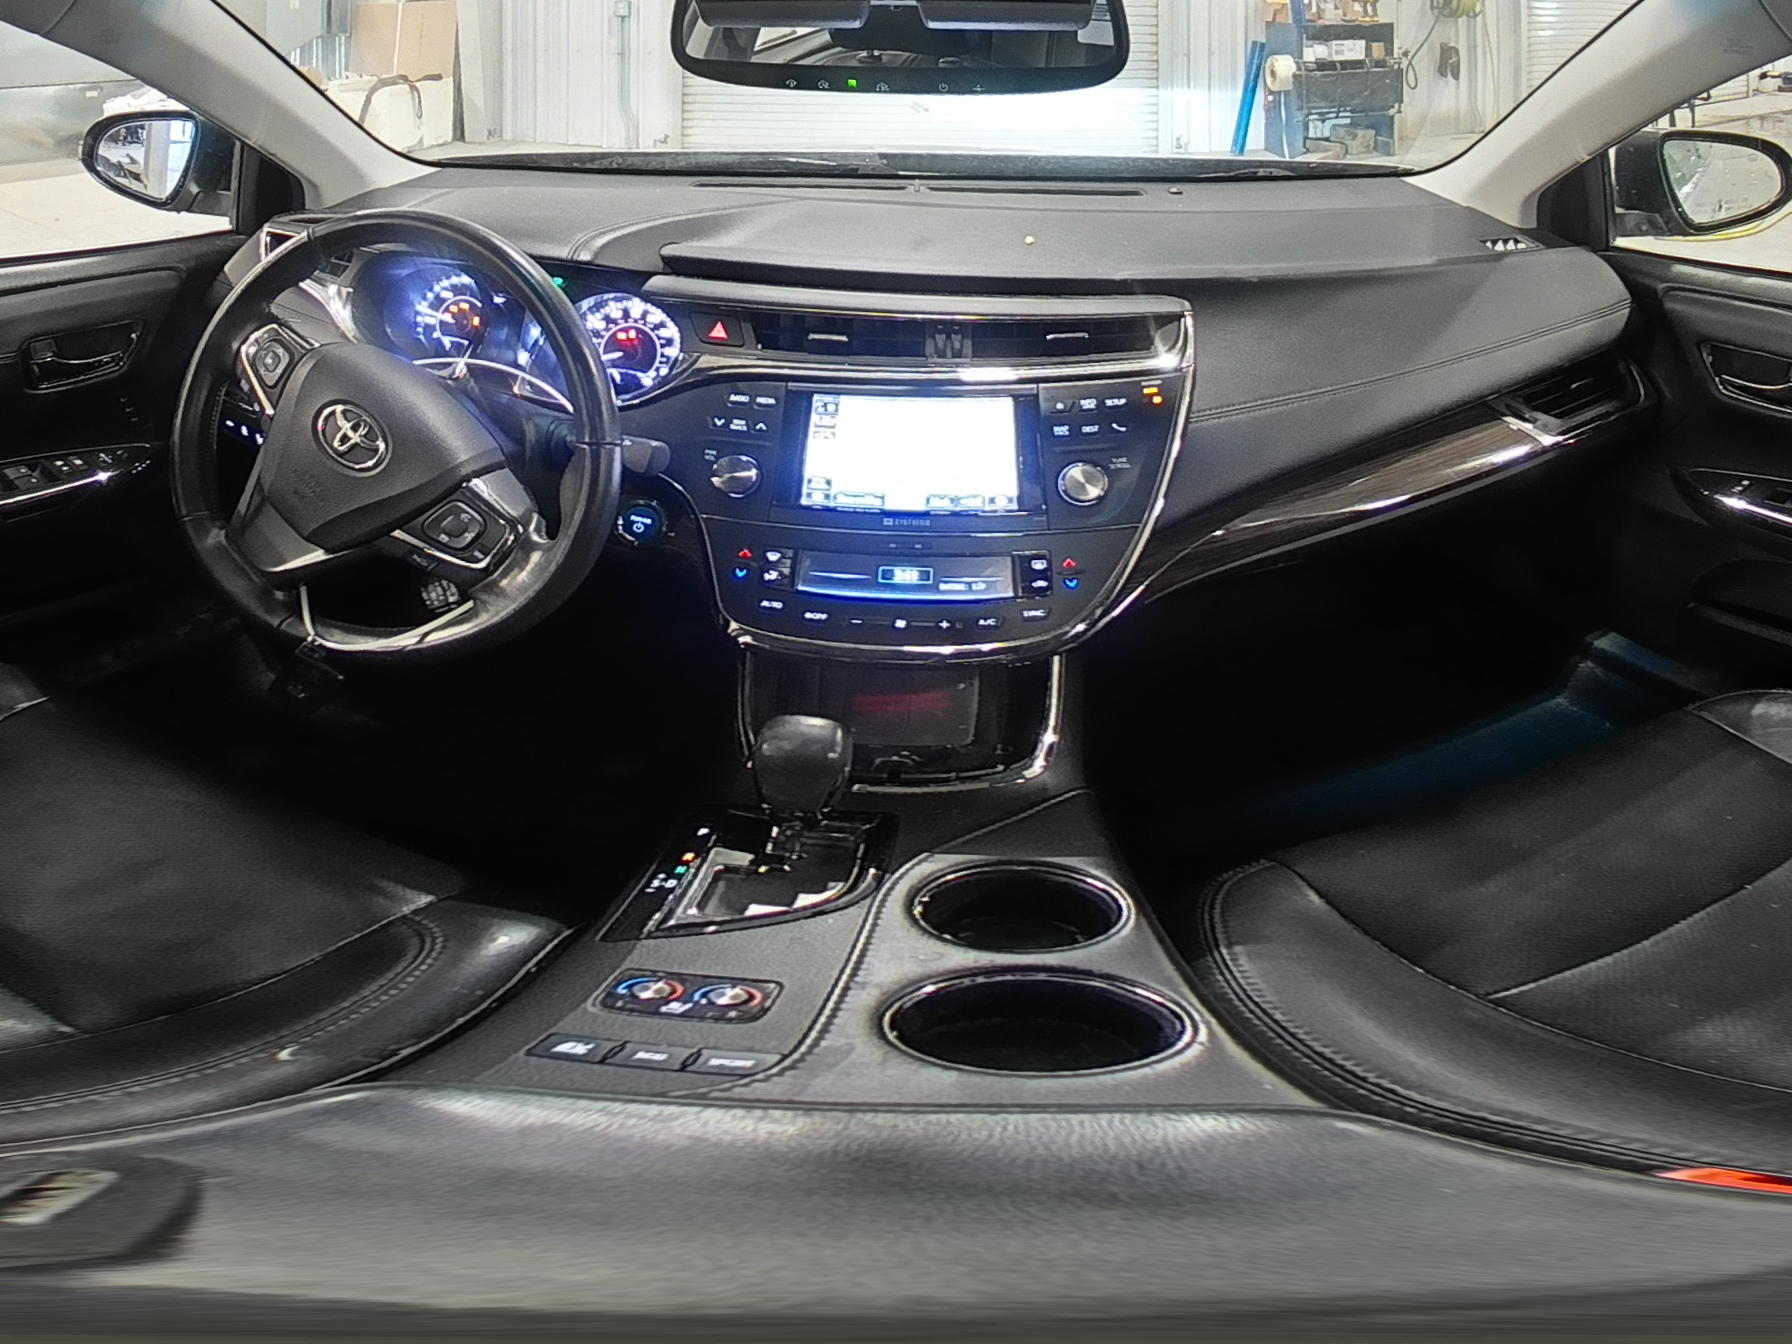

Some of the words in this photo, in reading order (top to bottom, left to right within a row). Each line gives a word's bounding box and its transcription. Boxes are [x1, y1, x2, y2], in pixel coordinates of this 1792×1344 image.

[1081, 425, 1099, 433] DEST
[760, 600, 784, 609] AUTO
[978, 618, 997, 626] A/C
